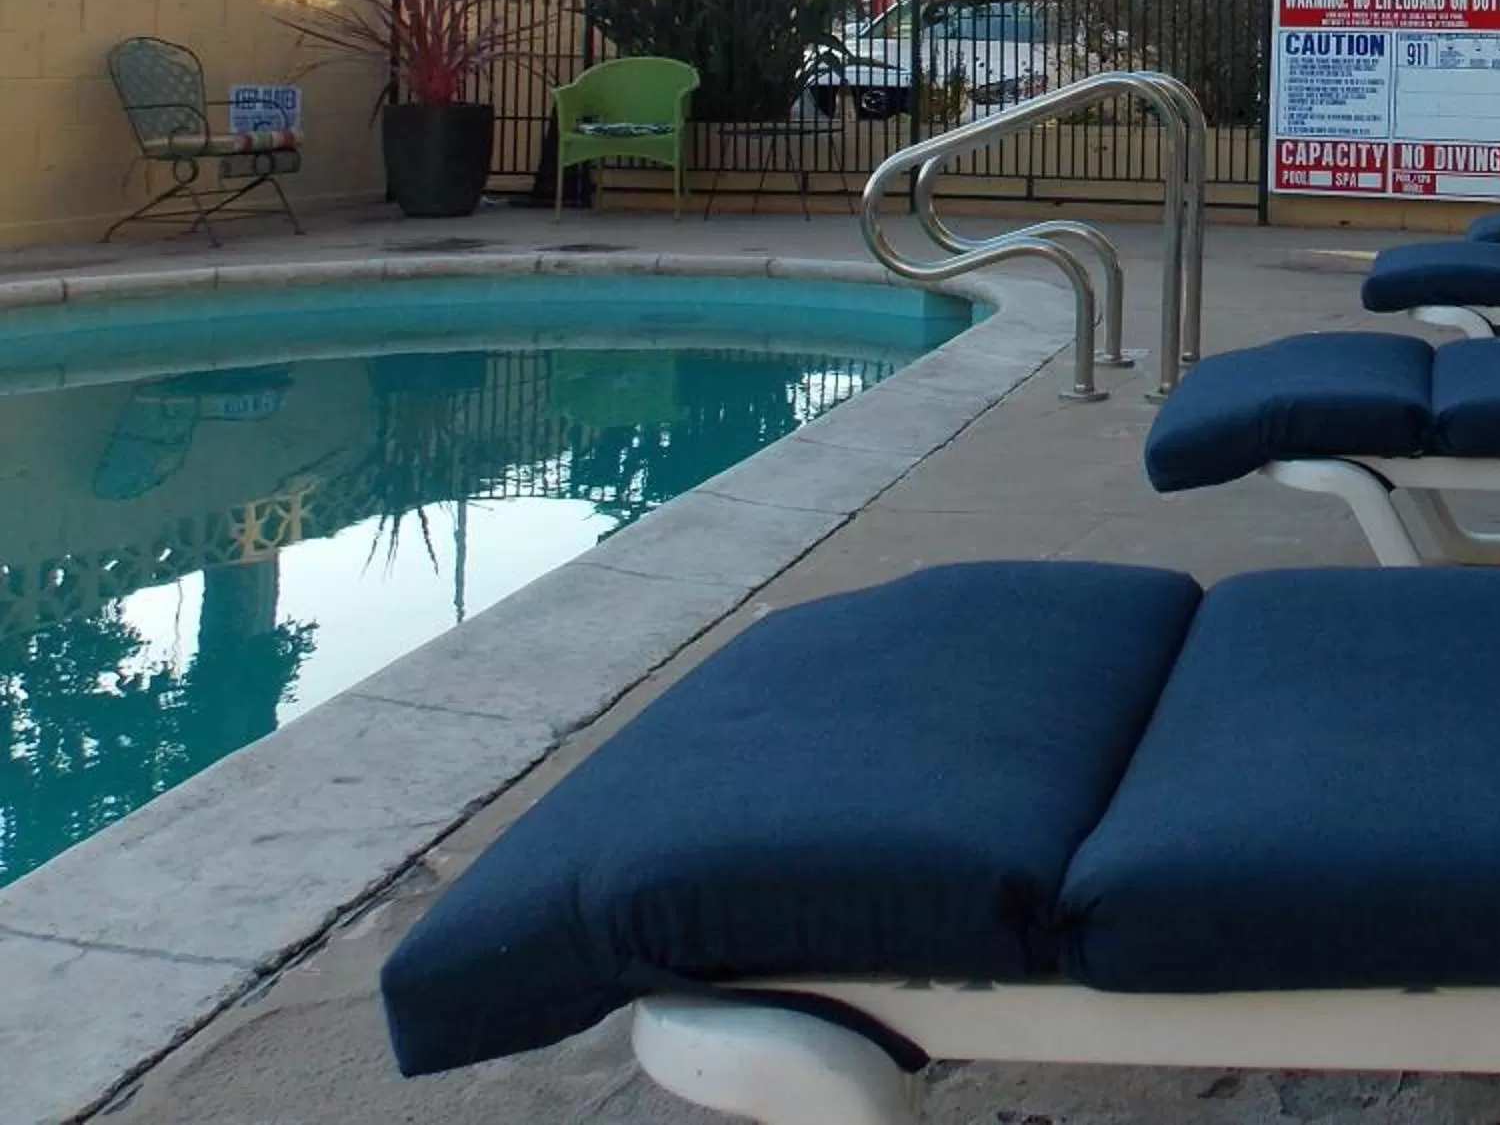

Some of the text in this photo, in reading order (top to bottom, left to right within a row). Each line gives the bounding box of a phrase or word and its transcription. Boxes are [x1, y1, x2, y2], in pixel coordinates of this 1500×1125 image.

[1285, 33, 1385, 57] CAUTION
[1407, 42, 1429, 66] 911
[1281, 140, 1385, 168] CAPACITY
[1401, 144, 1500, 172] NO DIVING
[1282, 170, 1309, 185] POOL
[1335, 172, 1357, 188] SPA
